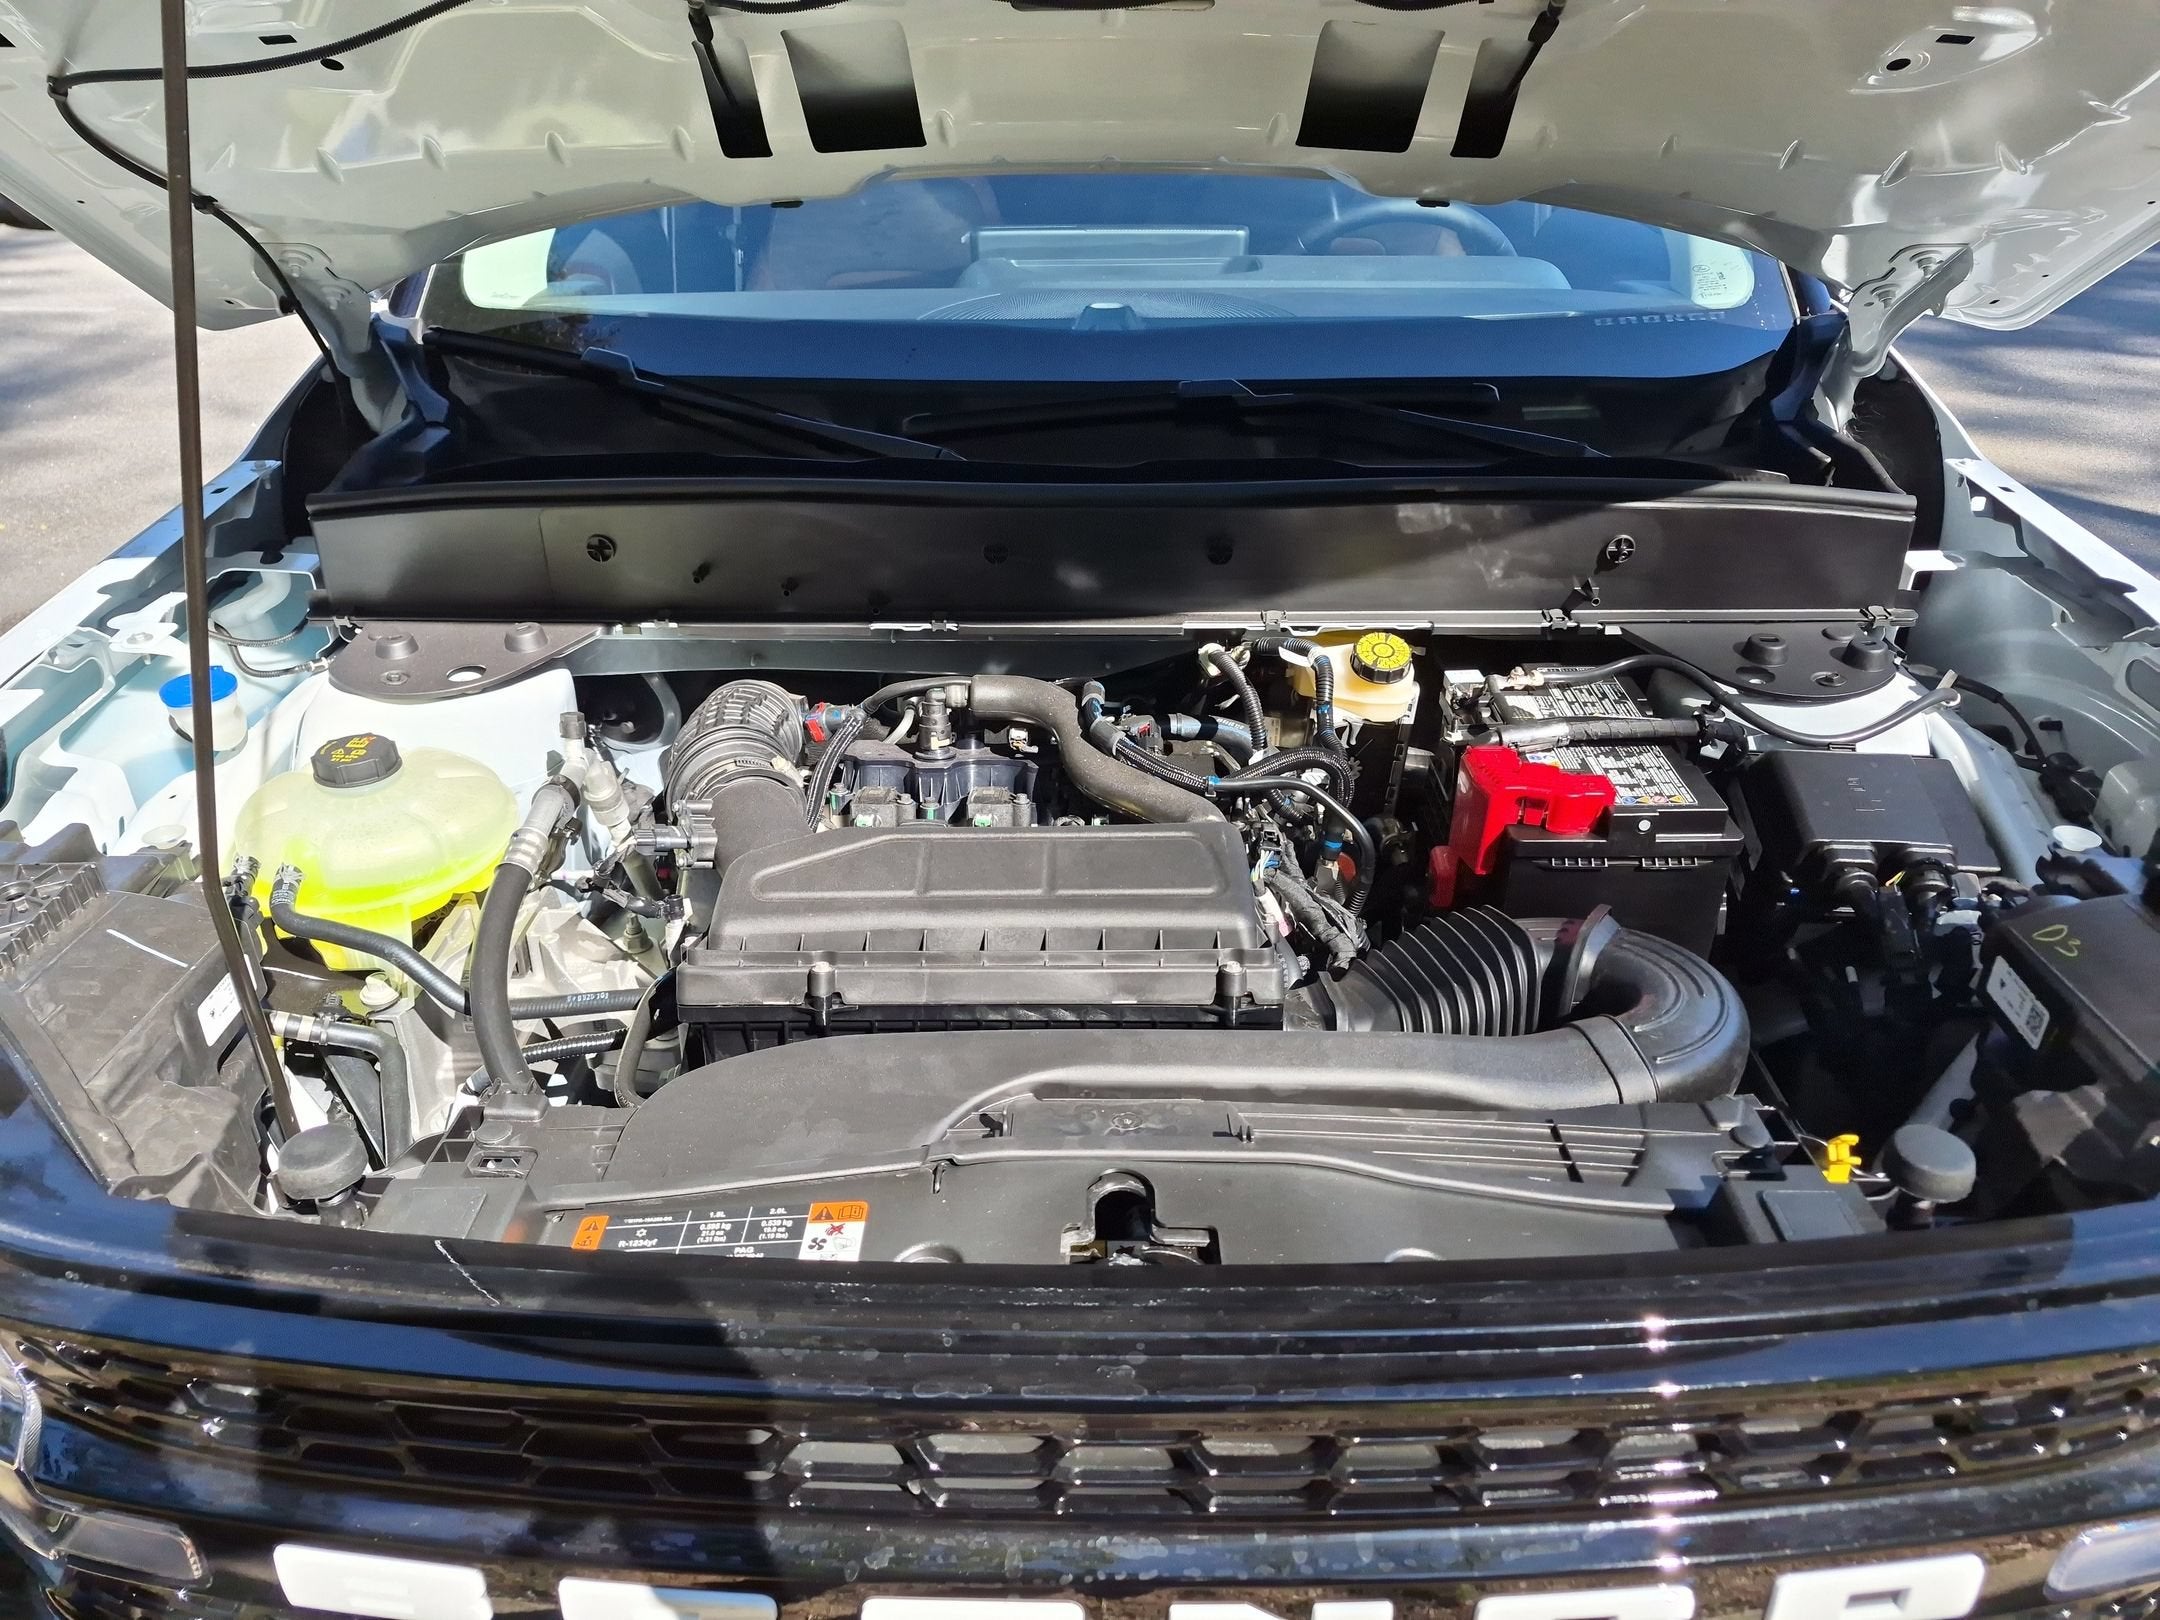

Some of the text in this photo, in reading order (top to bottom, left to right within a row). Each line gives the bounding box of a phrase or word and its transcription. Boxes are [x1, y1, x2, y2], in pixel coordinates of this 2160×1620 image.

[721, 1222, 732, 1231] kg
[782, 1219, 793, 1227] kg
[618, 1238, 658, 1248] R-1234yf
[734, 1246, 755, 1254] PAG
